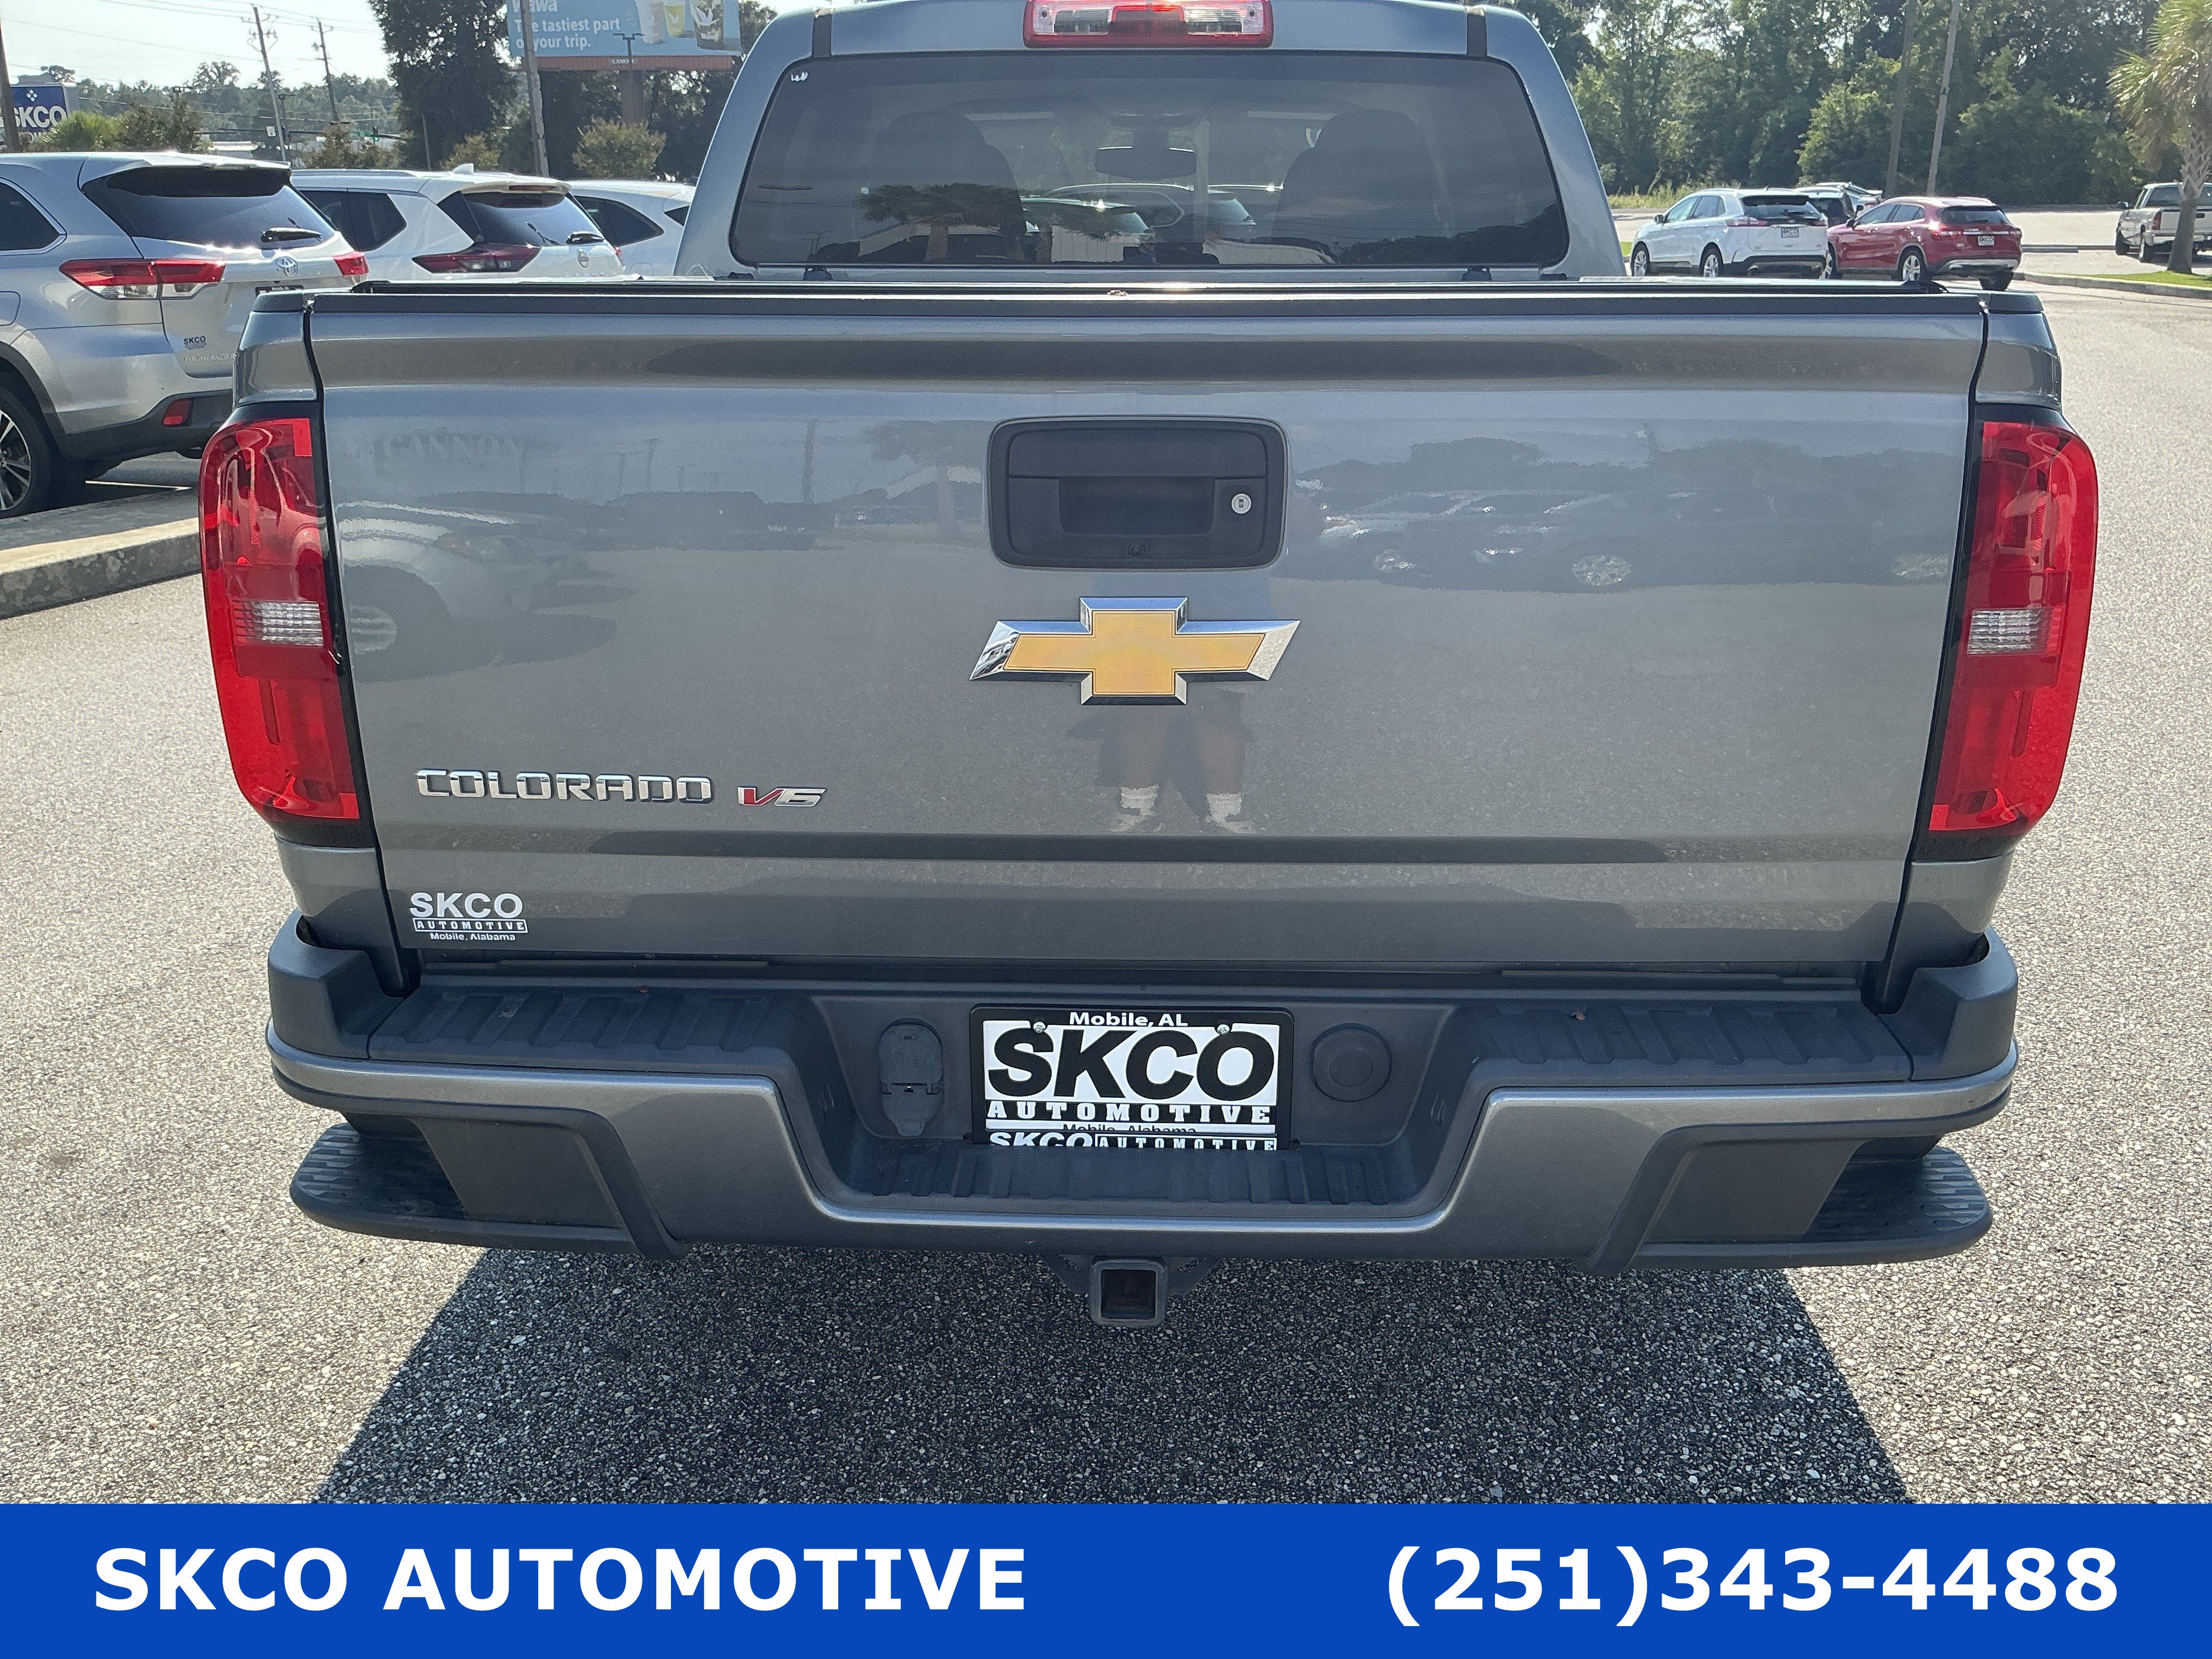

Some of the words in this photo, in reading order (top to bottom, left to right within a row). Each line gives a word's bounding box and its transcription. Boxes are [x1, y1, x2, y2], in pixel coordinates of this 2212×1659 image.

[514, 19, 539, 33] Te
[542, 18, 590, 32] tastiest
[594, 18, 620, 34] part
[516, 38, 524, 49] o
[533, 37, 562, 52] your
[565, 33, 591, 50] trip.
[184, 335, 206, 345] SKCO
[185, 353, 236, 362] HIGHLANDER
[416, 769, 713, 804] COLORADO
[737, 786, 826, 807] V6
[410, 892, 523, 918] SKCO
[417, 921, 525, 930] AUTOMOTIVE
[430, 933, 467, 941] Mobile,
[1070, 1012, 1154, 1028] Mobile,
[1158, 1013, 1188, 1026] AL
[988, 1026, 1275, 1101] SKCO
[988, 1099, 1271, 1124] AUTOMOTIVE
[990, 1131, 1093, 1147] SKCO
[1099, 1136, 1274, 1151] AUTOMOTIVE
